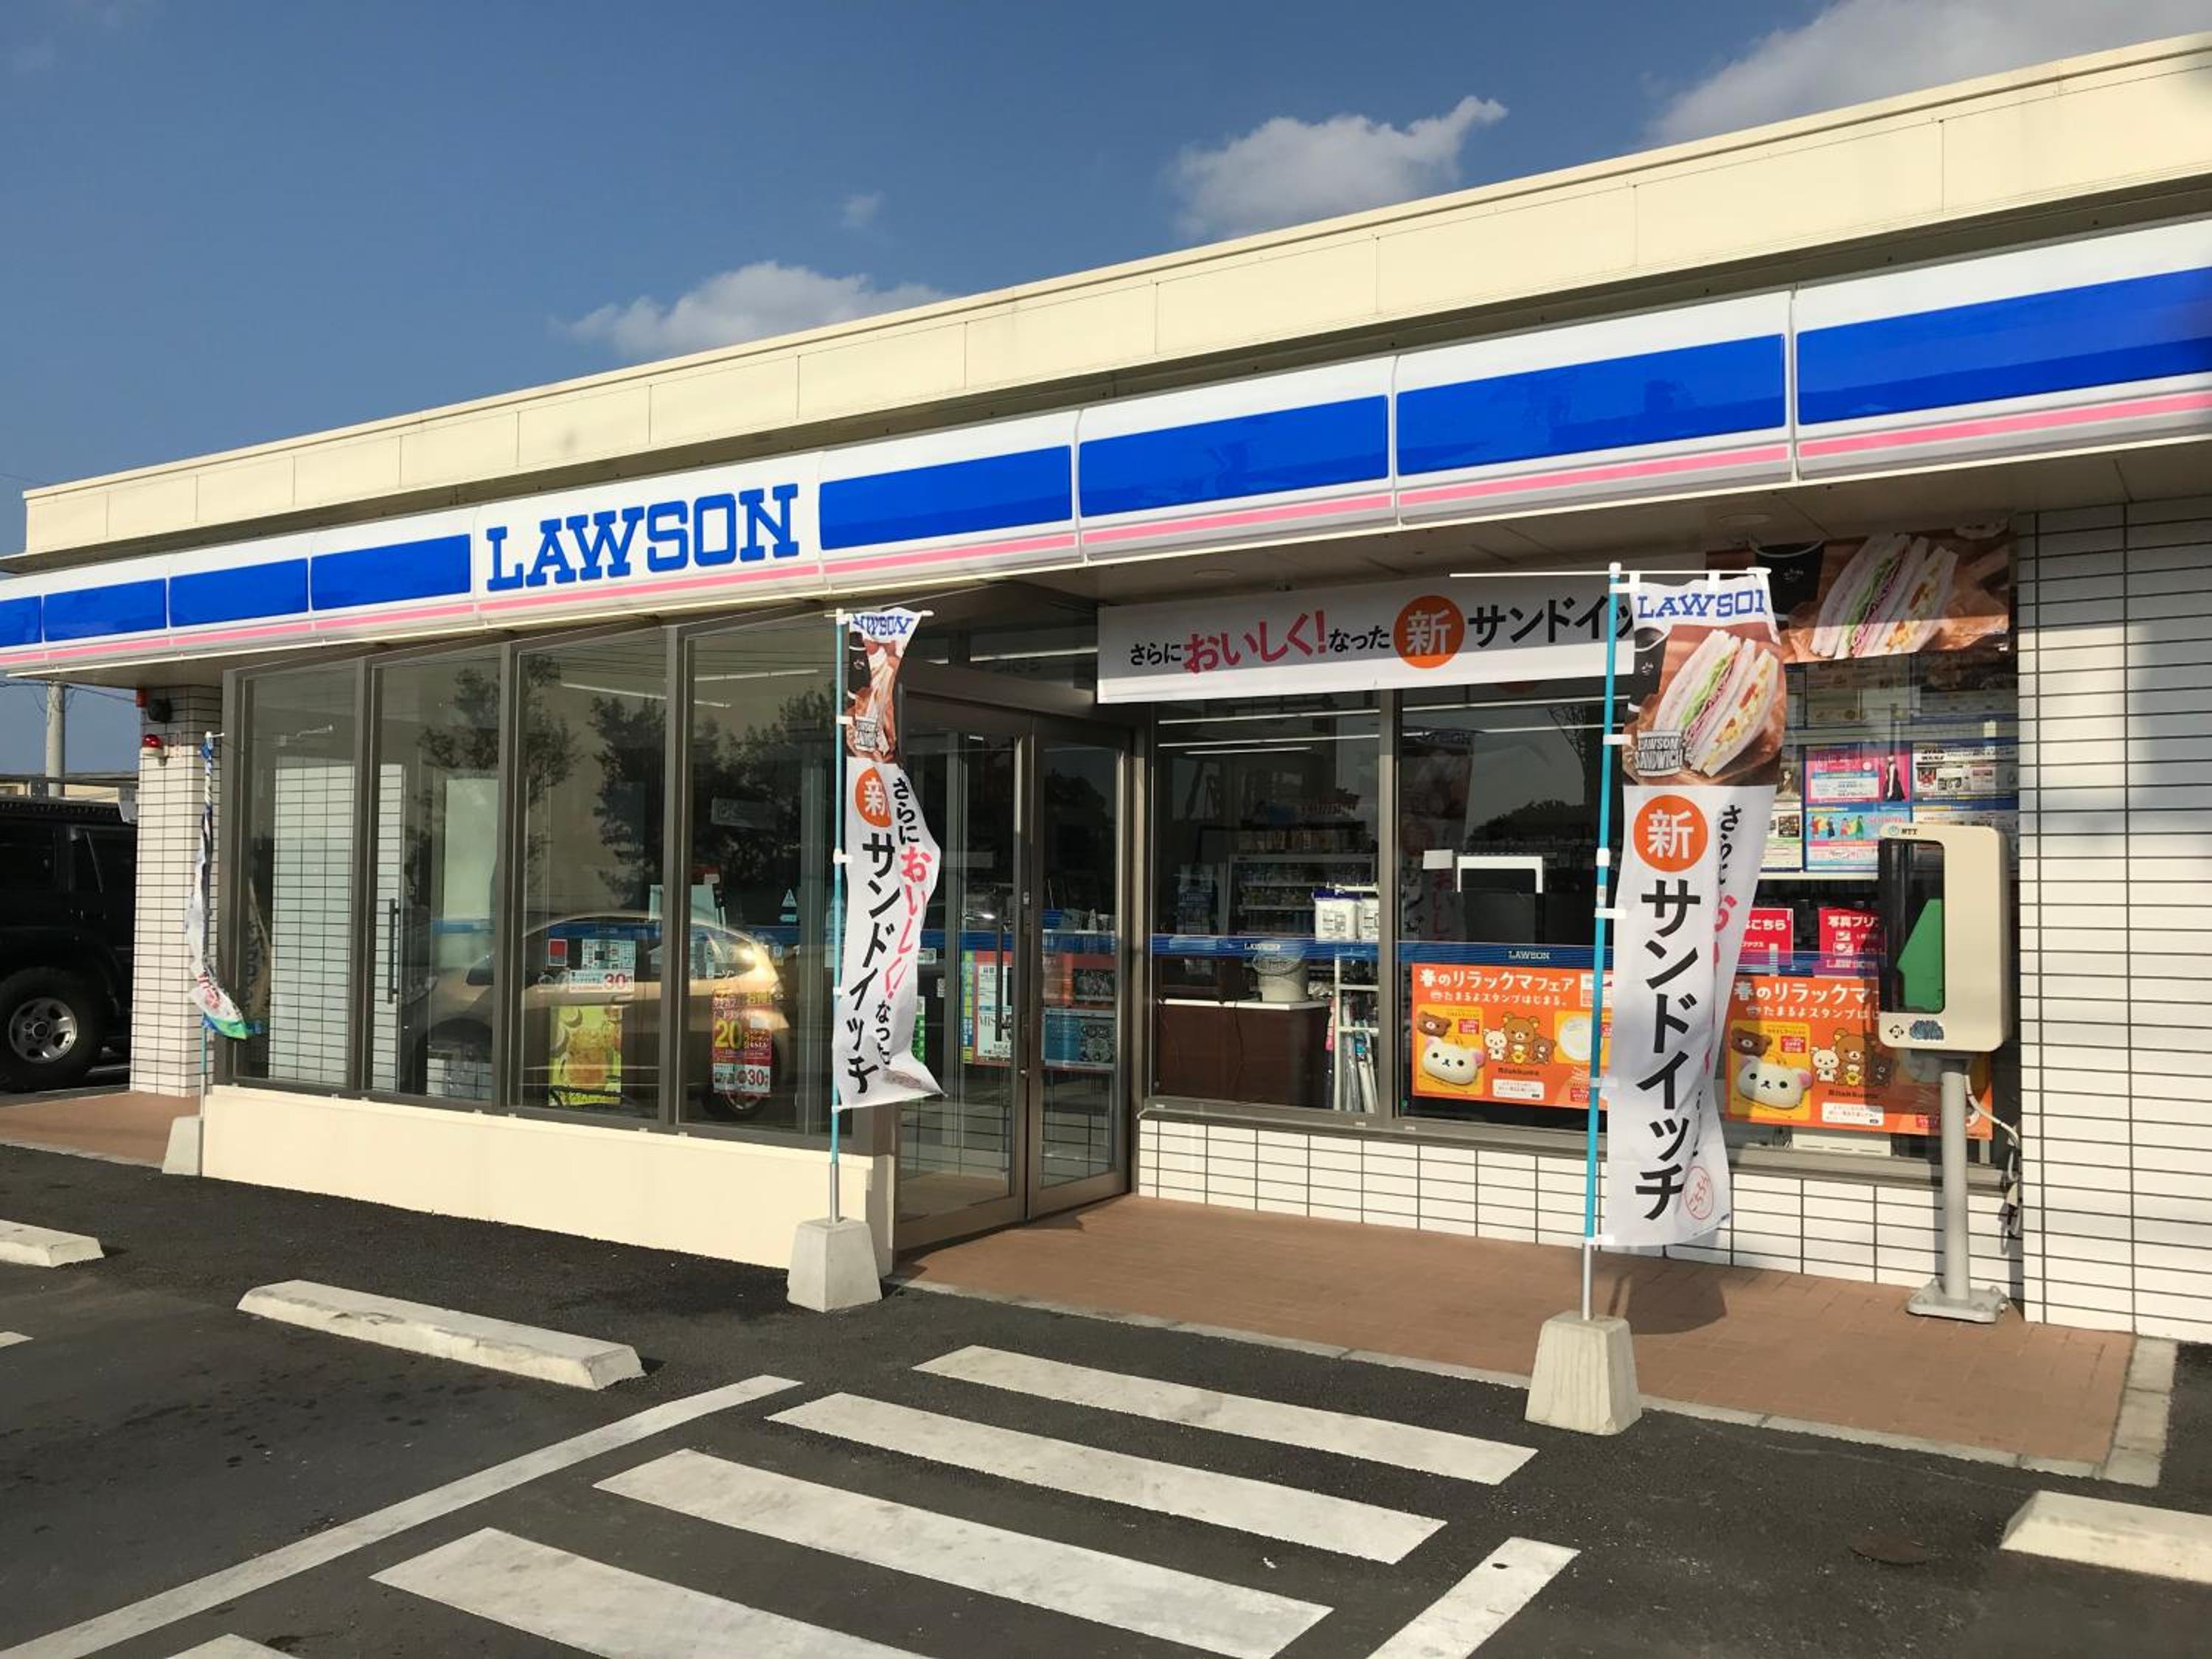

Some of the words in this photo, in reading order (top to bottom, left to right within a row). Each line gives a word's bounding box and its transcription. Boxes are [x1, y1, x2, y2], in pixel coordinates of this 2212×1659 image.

[487, 483, 799, 591] LAWSON
[1405, 608, 1452, 656] 新
[1646, 809, 1695, 859] 新
[847, 832, 901, 1094] サンドイッチ
[1419, 968, 1575, 992] 春のリラックマフェア
[1509, 950, 1551, 960] LAWSON
[1635, 878, 1701, 1221] サンドイッチ
